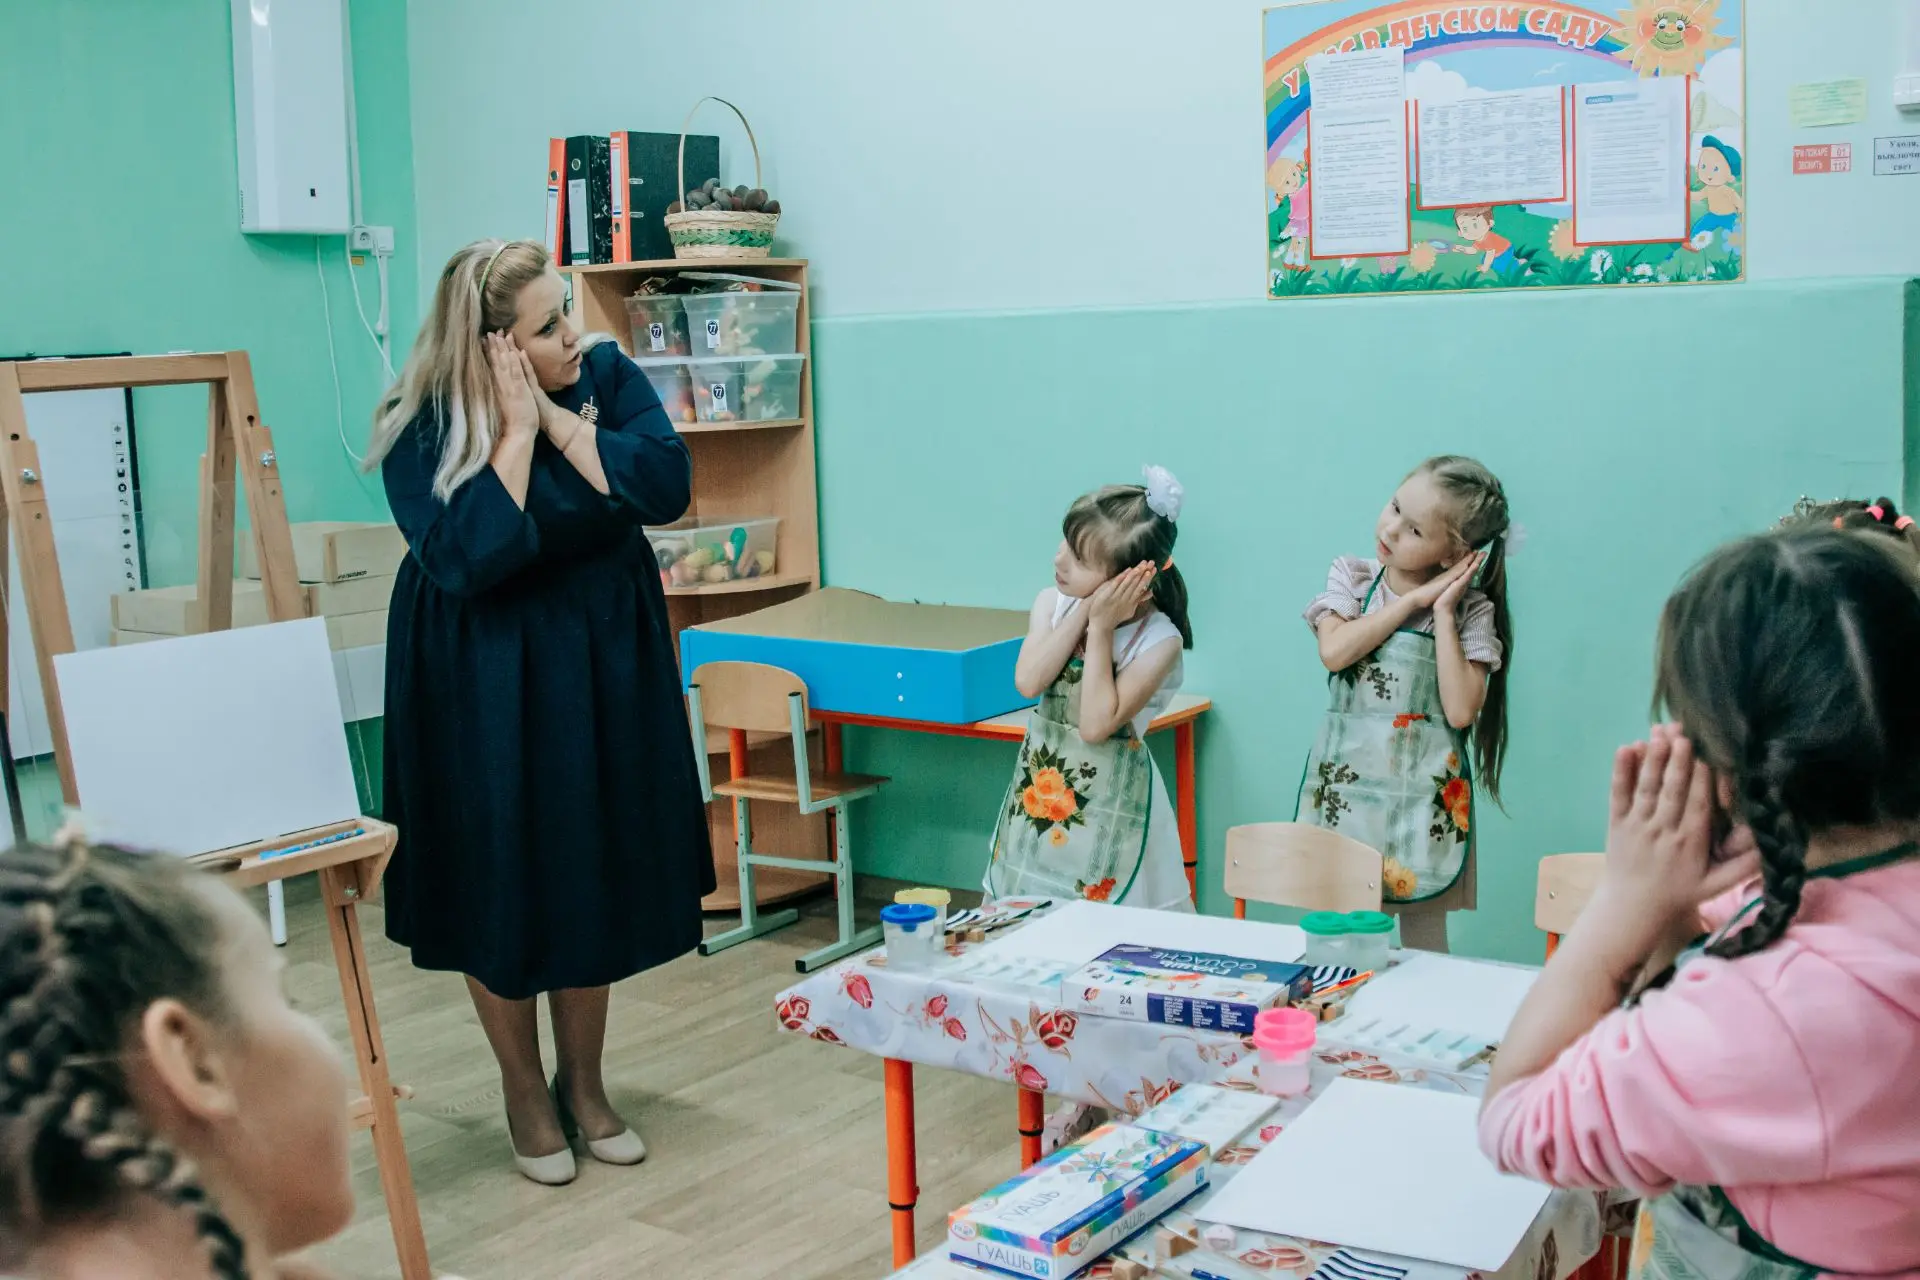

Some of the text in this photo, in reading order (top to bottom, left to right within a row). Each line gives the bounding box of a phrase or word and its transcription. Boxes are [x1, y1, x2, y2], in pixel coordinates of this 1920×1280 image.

[1282, 68, 1300, 98] У
[1388, 7, 1520, 49] ДЕТСКОМ
[1525, 7, 1611, 49] САДУ
[1152, 951, 1257, 970] GOUACHE
[1119, 995, 1132, 1005] 24
[996, 1190, 1060, 1221] ГУАШЬ
[1111, 1209, 1147, 1243] ГУАШЬ
[976, 1242, 1032, 1272] ГУАШЬ
